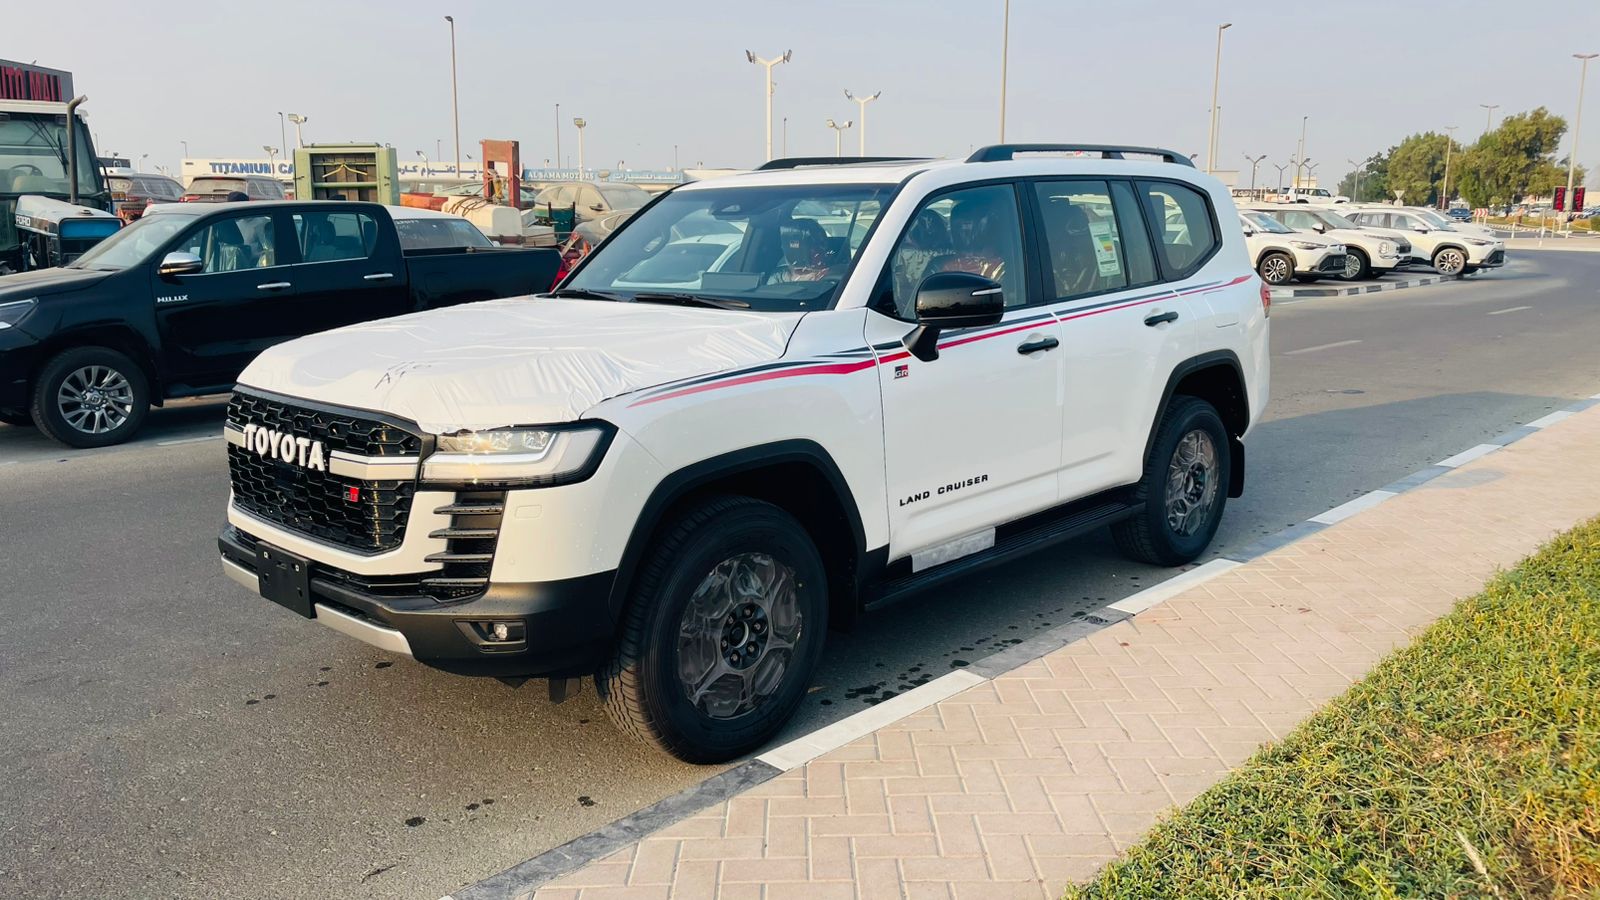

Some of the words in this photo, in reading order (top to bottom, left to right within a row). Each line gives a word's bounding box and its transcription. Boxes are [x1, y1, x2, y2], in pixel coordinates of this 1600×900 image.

[562, 171, 594, 180] MOTRS
[16, 215, 31, 226] FORD
[157, 294, 189, 303] HILUX
[895, 367, 908, 379] GR
[243, 423, 326, 472] TOYOTA
[899, 490, 930, 507] LAND
[937, 474, 989, 495] CRUISER
